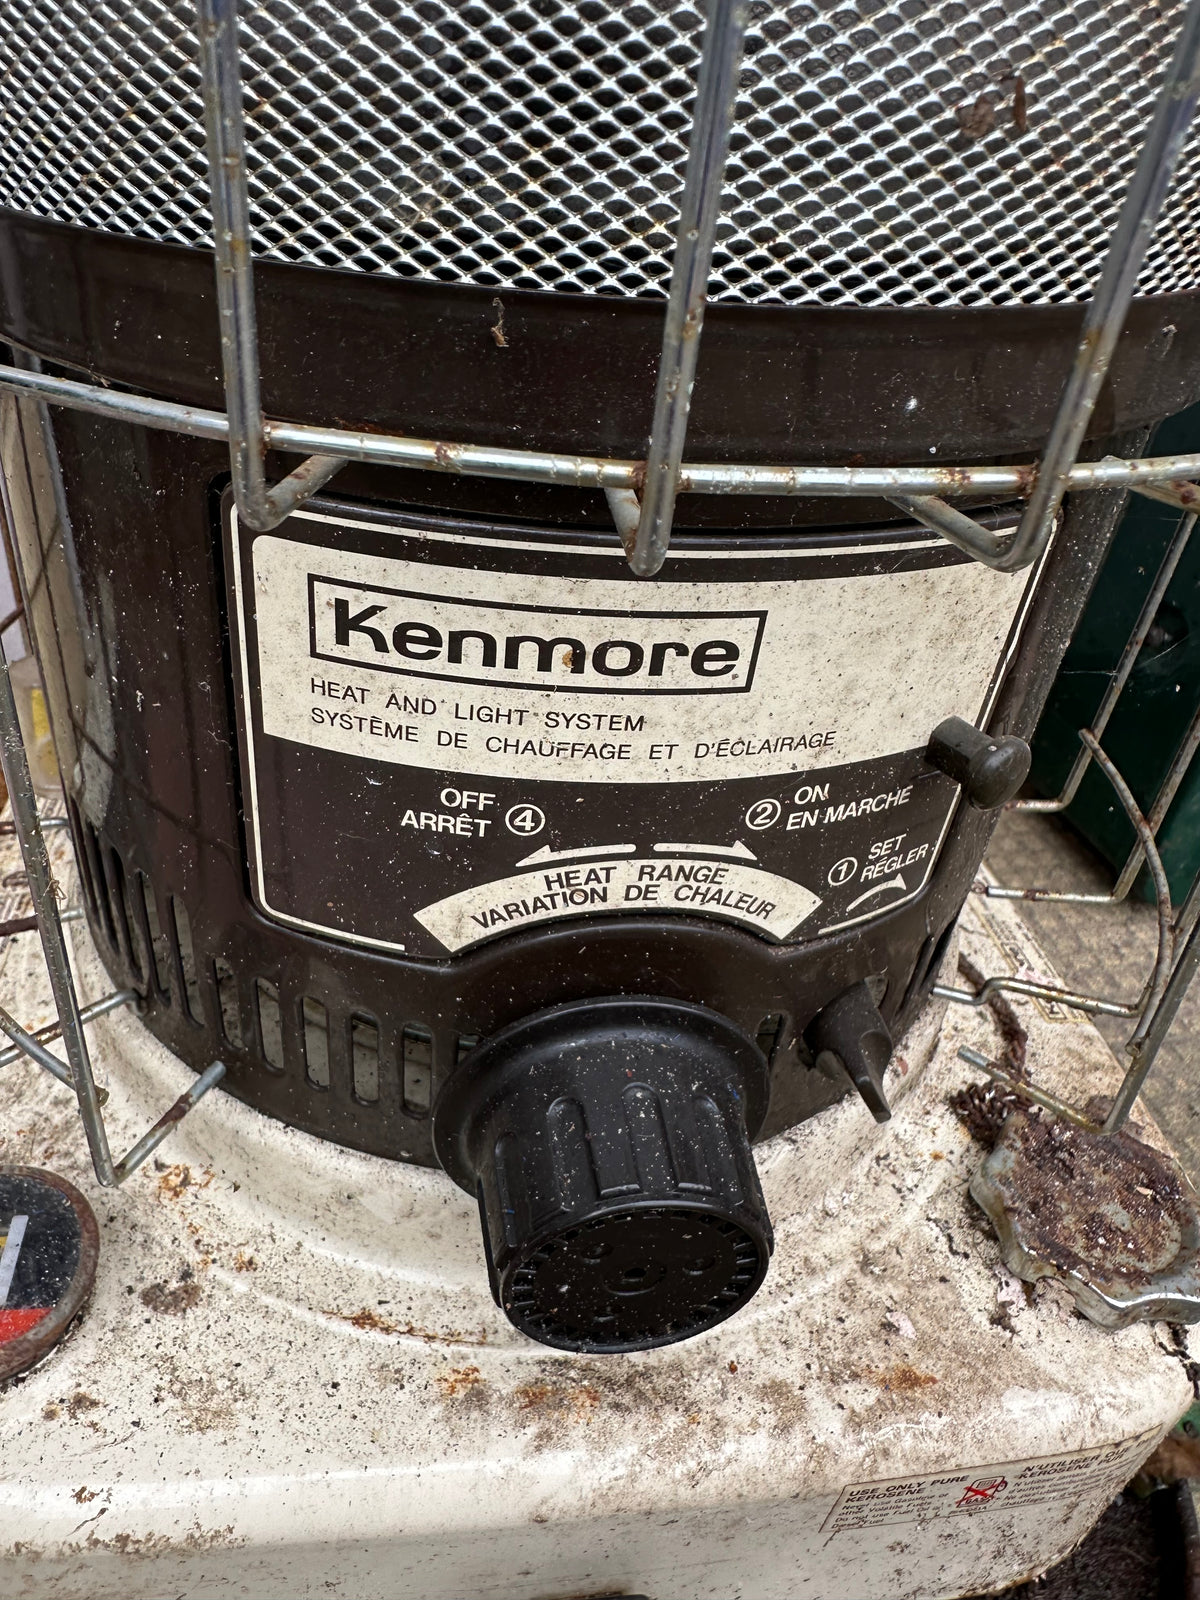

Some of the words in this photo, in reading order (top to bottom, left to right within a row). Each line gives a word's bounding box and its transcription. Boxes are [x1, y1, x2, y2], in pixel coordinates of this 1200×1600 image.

[334, 597, 740, 677] Kenmore
[311, 678, 370, 705] HEAT
[385, 693, 437, 716] AND
[454, 702, 530, 727] LIGHT
[544, 711, 645, 732] SYSTEM
[311, 707, 419, 743] SYSTÈME
[437, 730, 468, 749] DE
[485, 736, 631, 761] CHAUFFAGE
[649, 743, 679, 759] ET
[694, 731, 837, 759] D'ÉCLAIRAGE
[440, 787, 496, 811] OFF
[786, 810, 820, 831] EN
[823, 785, 914, 824] MARCHE
[794, 783, 830, 805] ON
[400, 809, 492, 838] ARRÊT
[868, 834, 906, 860] SET
[860, 844, 928, 882] RÉGLER
[544, 866, 617, 891] HEAT
[638, 864, 729, 885] RANGE
[471, 886, 607, 929] VARIATION
[624, 884, 660, 901] DE
[674, 884, 776, 920] CHALEUR
[1022, 1454, 1101, 1473] N'UTILISER
[845, 1487, 926, 1504] KEROSENE
[849, 1487, 881, 1497] USE
[885, 1481, 926, 1492] ONLY
[930, 1474, 970, 1486] PURE
